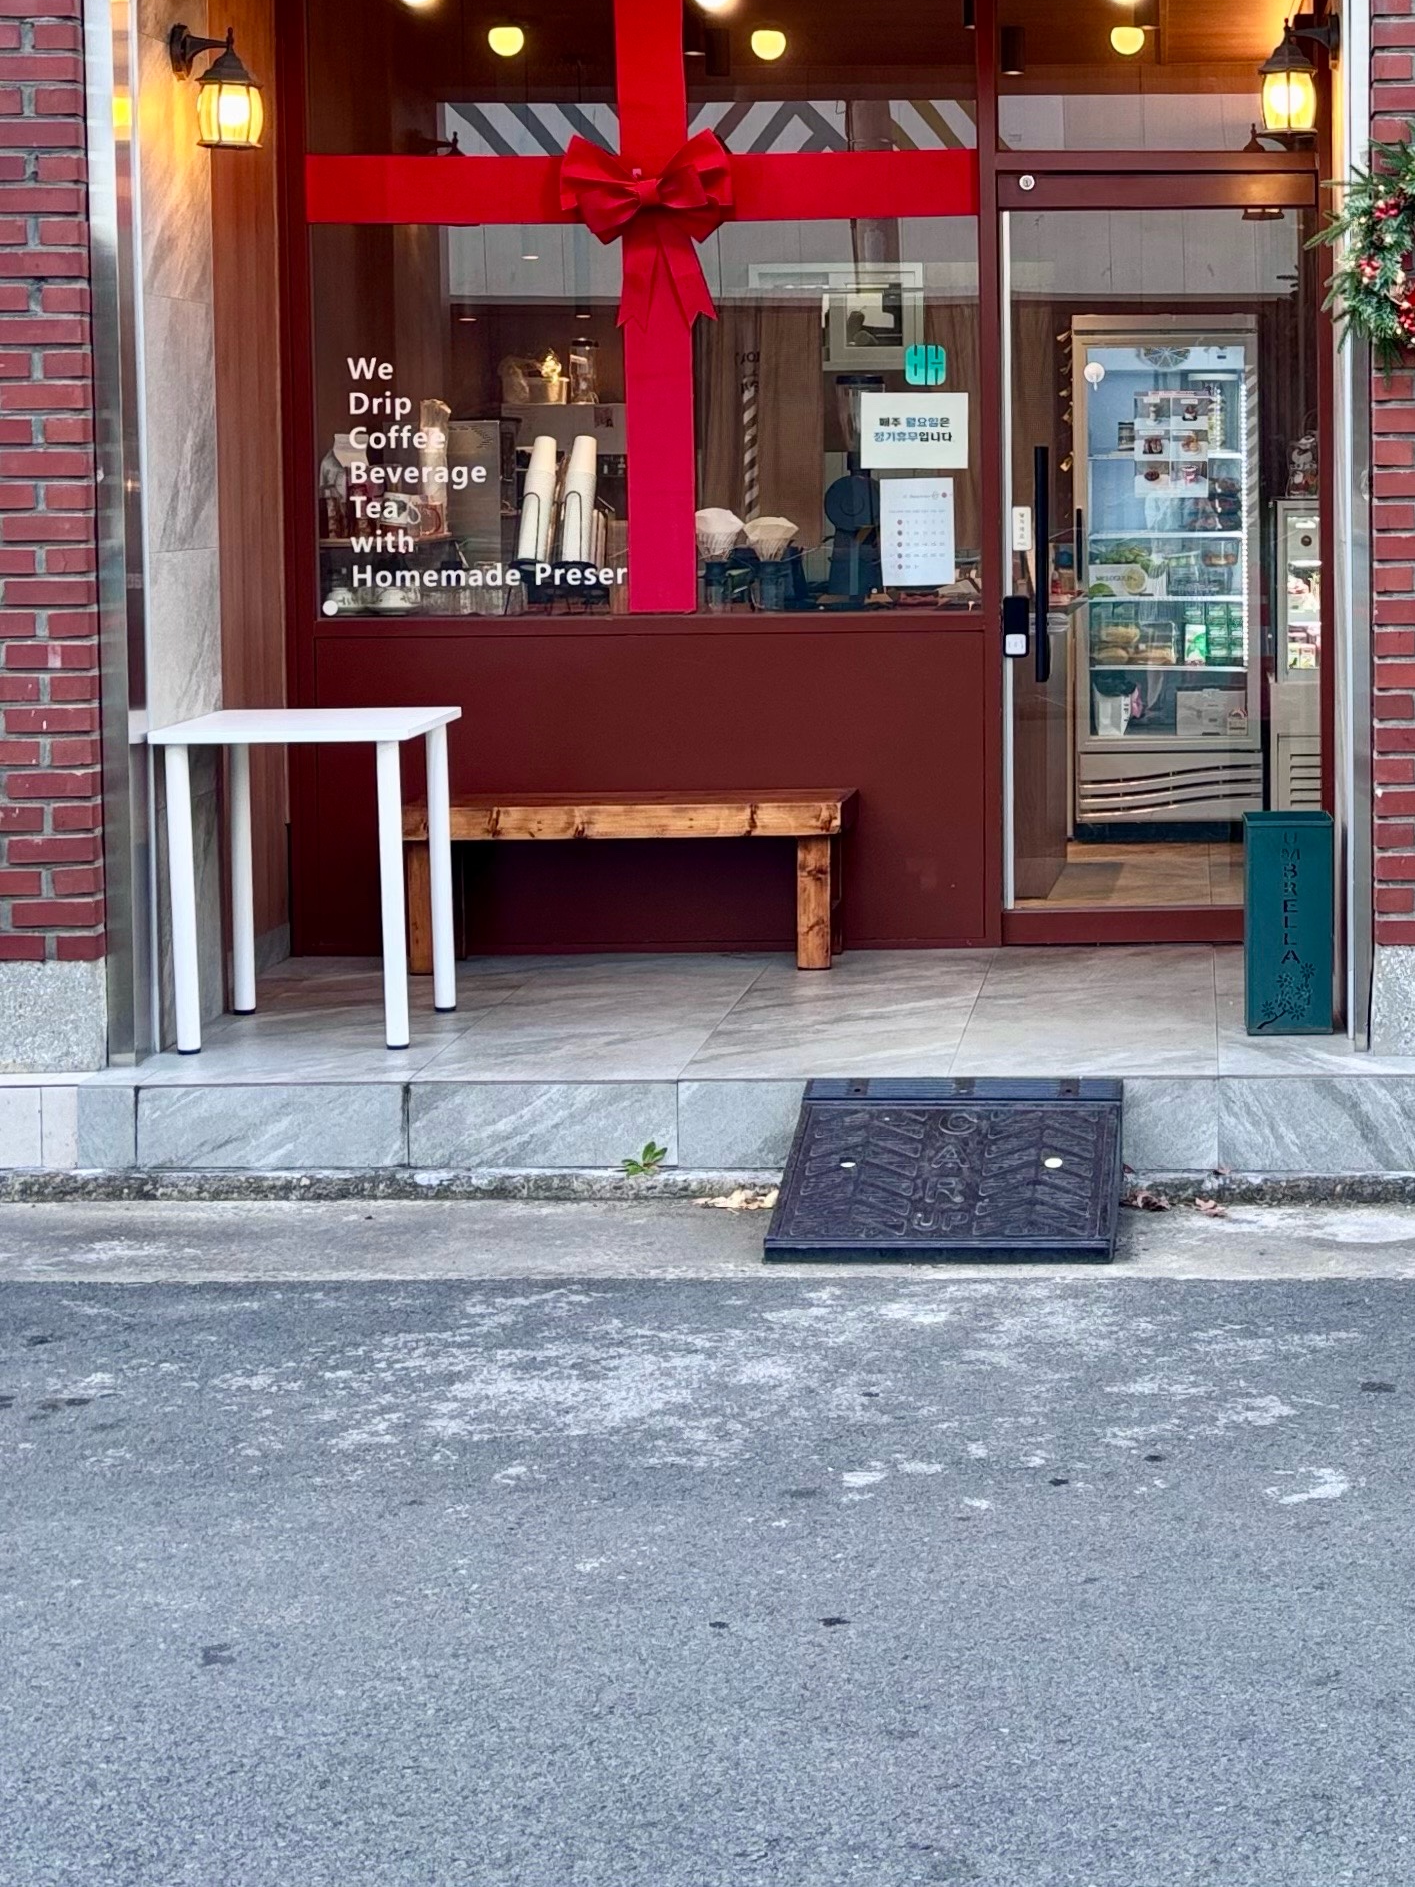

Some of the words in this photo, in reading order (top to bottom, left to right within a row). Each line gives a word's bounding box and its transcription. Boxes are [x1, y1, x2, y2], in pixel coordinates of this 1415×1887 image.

[347, 357, 394, 380] We
[349, 391, 412, 420] Drip
[349, 425, 447, 450] Coffee
[350, 462, 487, 489] Beverage
[350, 496, 399, 519] Tea
[350, 529, 414, 553] with
[352, 563, 521, 588] Homemade
[535, 564, 627, 586] Preser
[1281, 831, 1301, 964] UMBRELLA
